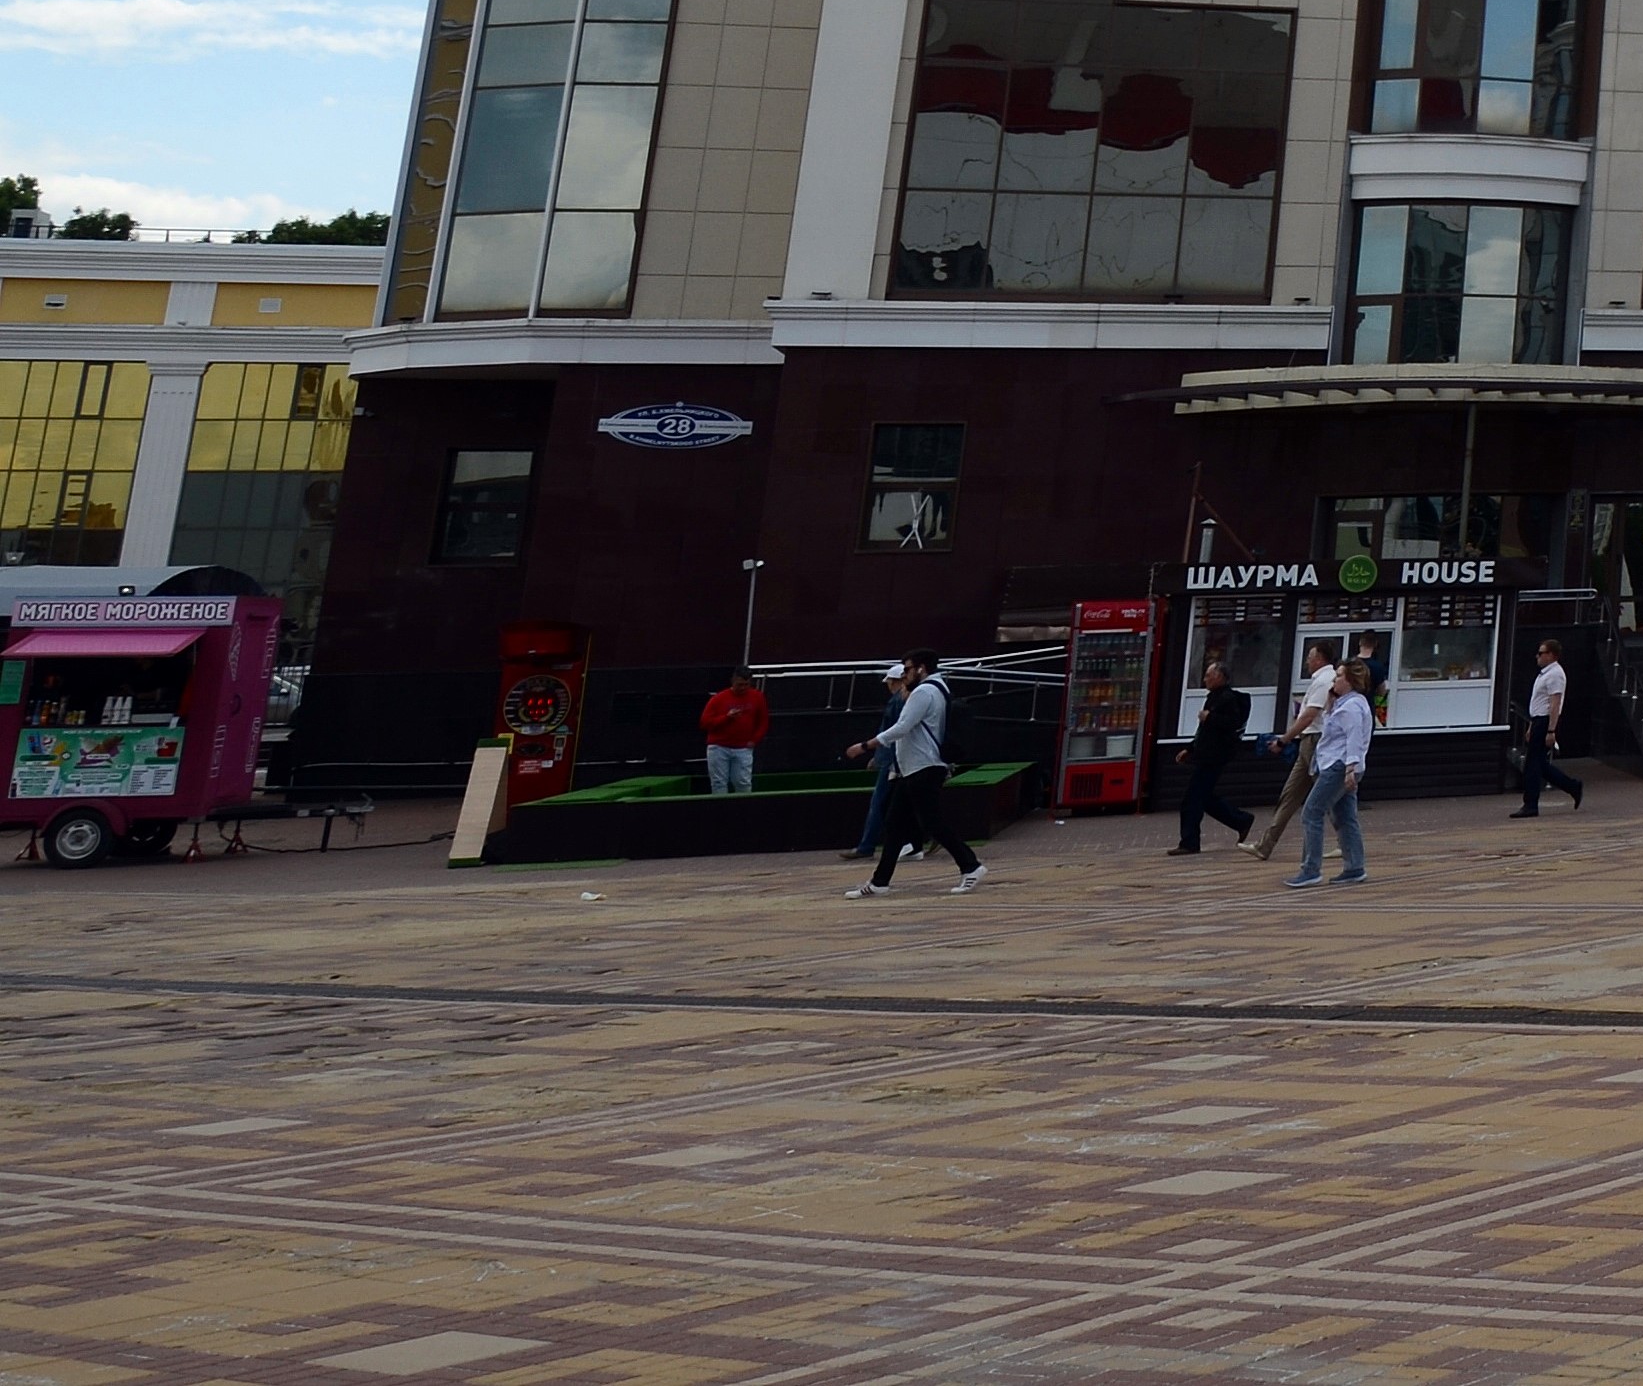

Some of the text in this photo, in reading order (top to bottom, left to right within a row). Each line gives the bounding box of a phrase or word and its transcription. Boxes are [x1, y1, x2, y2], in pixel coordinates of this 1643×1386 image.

[661, 419, 692, 434] 28
[1186, 564, 1320, 590] ШАУРМА
[1401, 560, 1496, 585] HOUSE
[20, 602, 230, 621] МЯГКОЕ МОРОЖЕНОЕ
